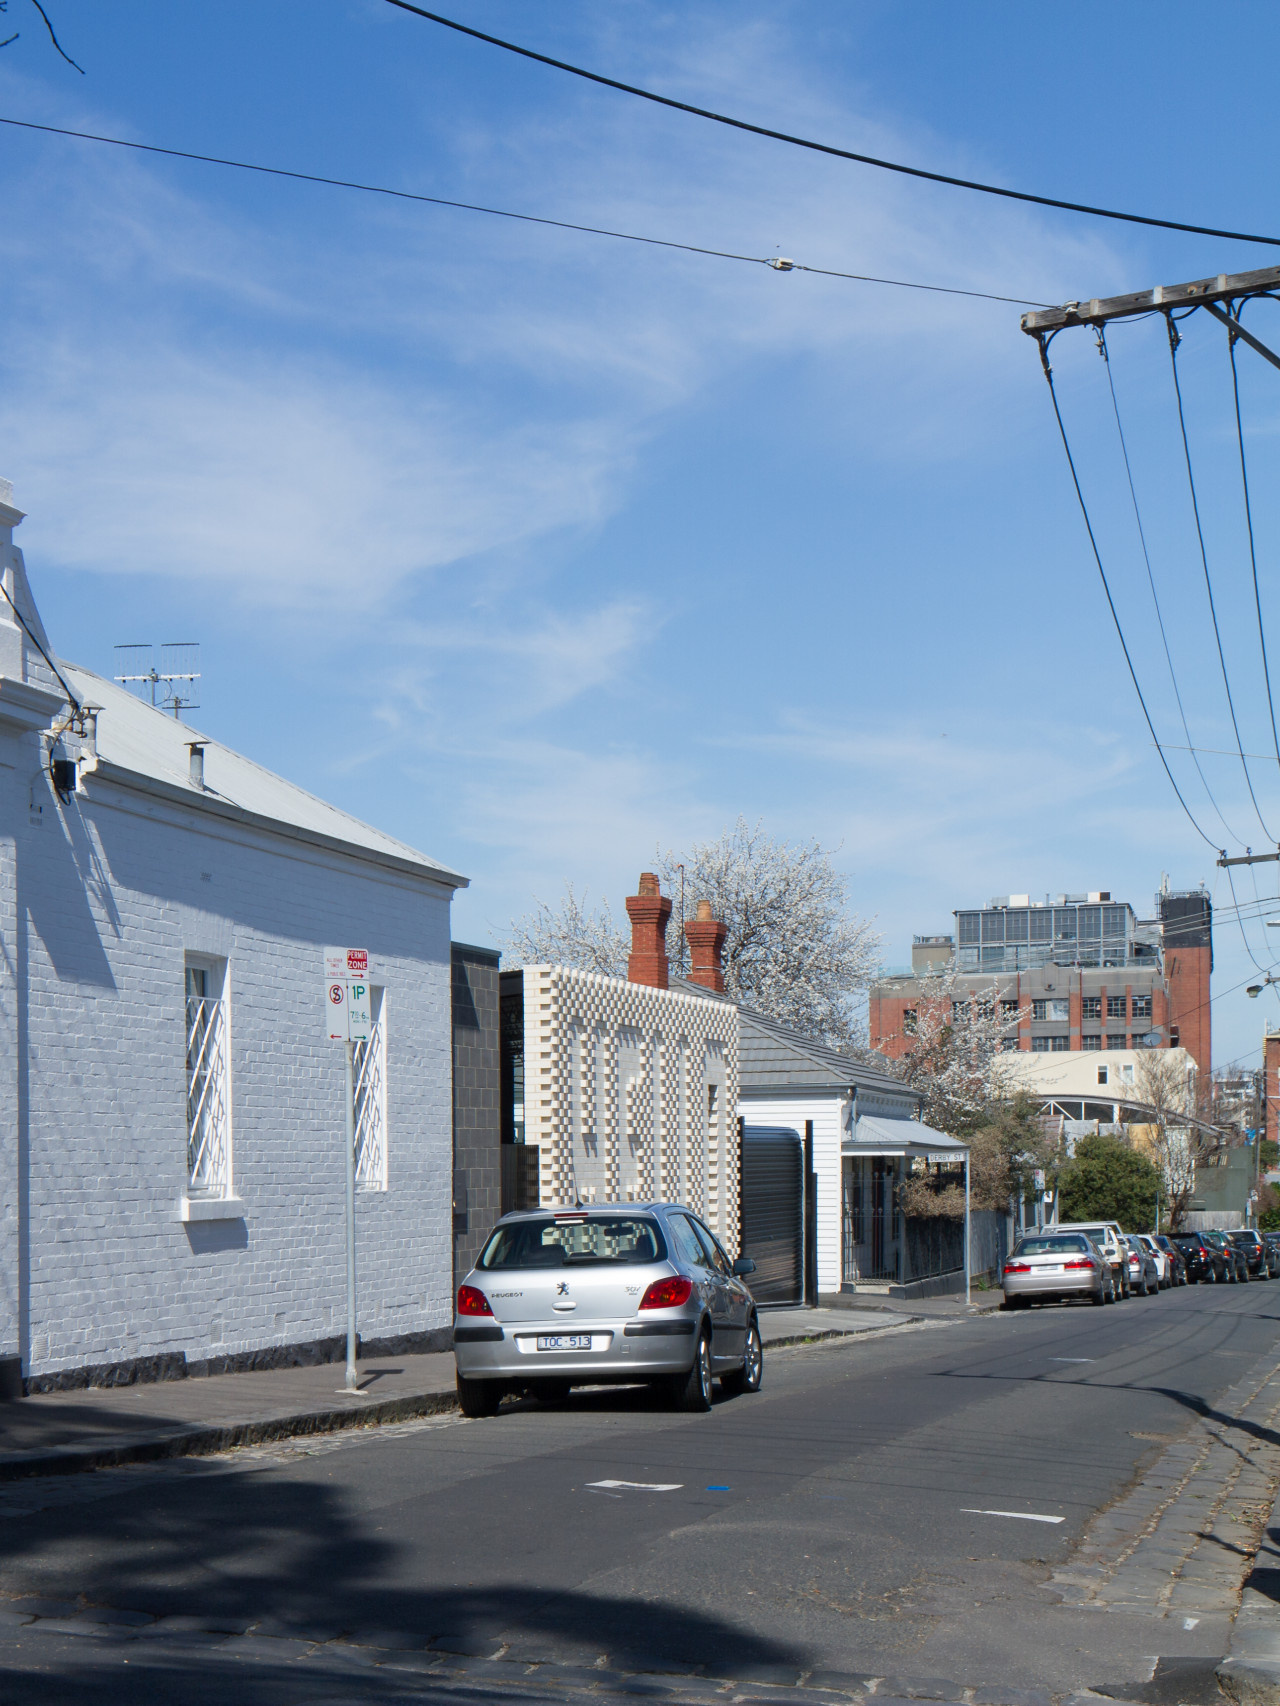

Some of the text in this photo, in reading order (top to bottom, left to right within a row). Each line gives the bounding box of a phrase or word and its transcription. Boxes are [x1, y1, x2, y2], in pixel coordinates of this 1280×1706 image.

[347, 950, 367, 960] PERMIT
[347, 960, 367, 970] ZONE
[352, 985, 365, 1000] 1P
[491, 1291, 523, 1299] PEUGEOT
